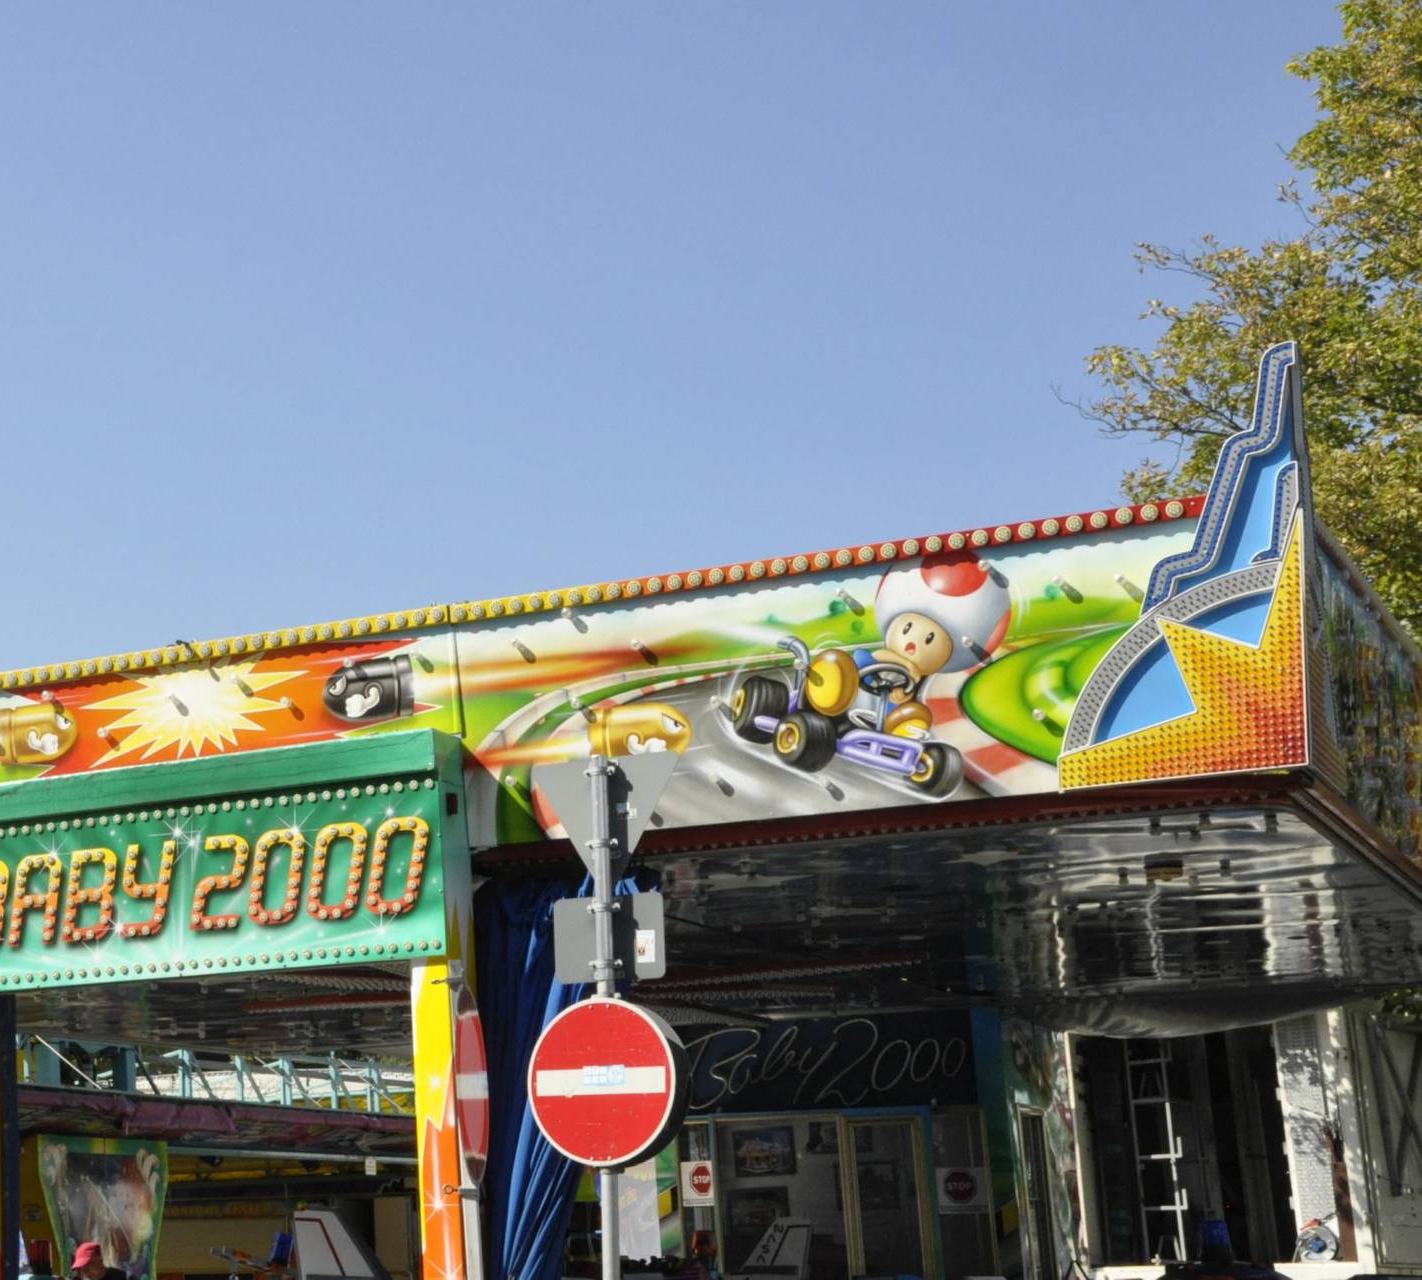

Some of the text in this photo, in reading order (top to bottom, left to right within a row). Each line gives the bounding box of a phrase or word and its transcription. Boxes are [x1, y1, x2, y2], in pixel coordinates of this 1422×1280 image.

[189, 816, 429, 931] 2000
[684, 1018, 966, 1110] Baby 2000
[693, 1175, 710, 1184] STOP
[946, 1181, 972, 1191] STOP
[756, 1223, 784, 1264] NASA
